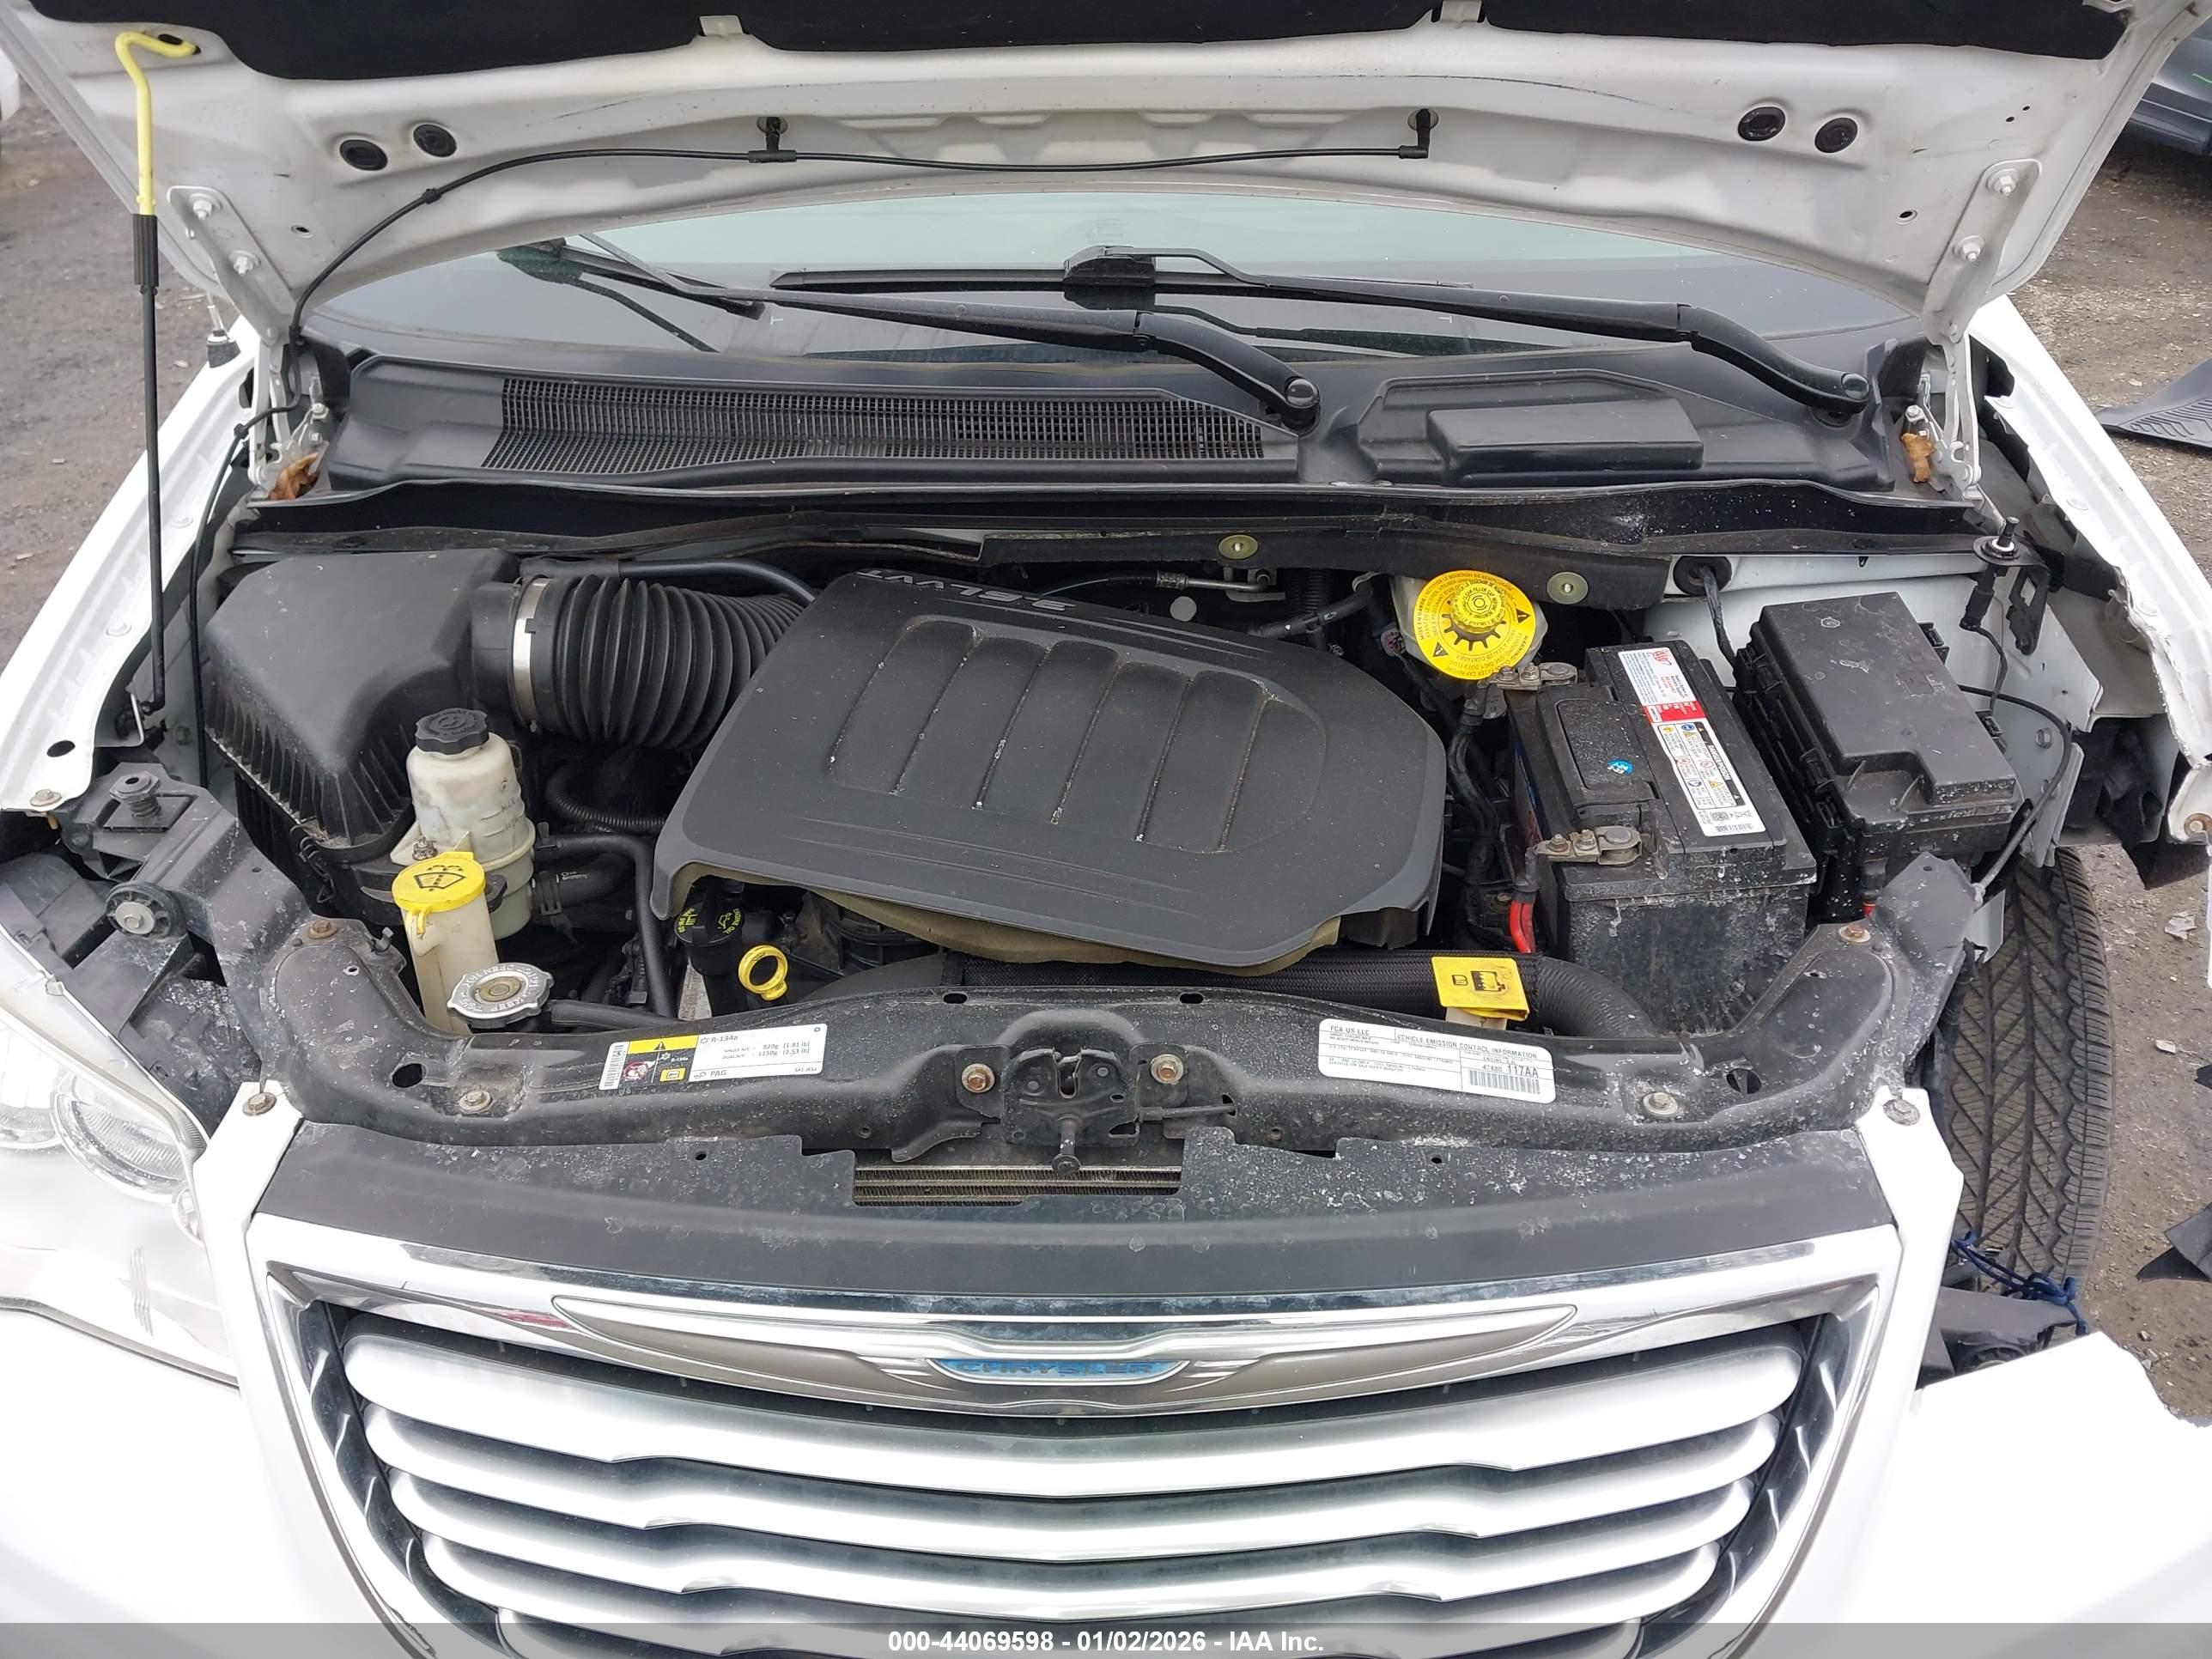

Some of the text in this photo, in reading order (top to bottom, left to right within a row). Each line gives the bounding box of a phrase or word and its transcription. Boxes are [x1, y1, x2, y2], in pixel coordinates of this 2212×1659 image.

[857, 570, 945, 589] VVT
[1417, 597, 1426, 616] GARDE
[1397, 1034, 1424, 1043] VEHICLE
[1425, 1037, 1457, 1048] EMISSION
[1460, 1042, 1489, 1053] CONTROL
[1492, 1048, 1537, 1059] INFORMATION
[710, 1069, 727, 1078] PAG
[1508, 1065, 1539, 1079] 117AA
[961, 1361, 1154, 1375] CHRYSLER
